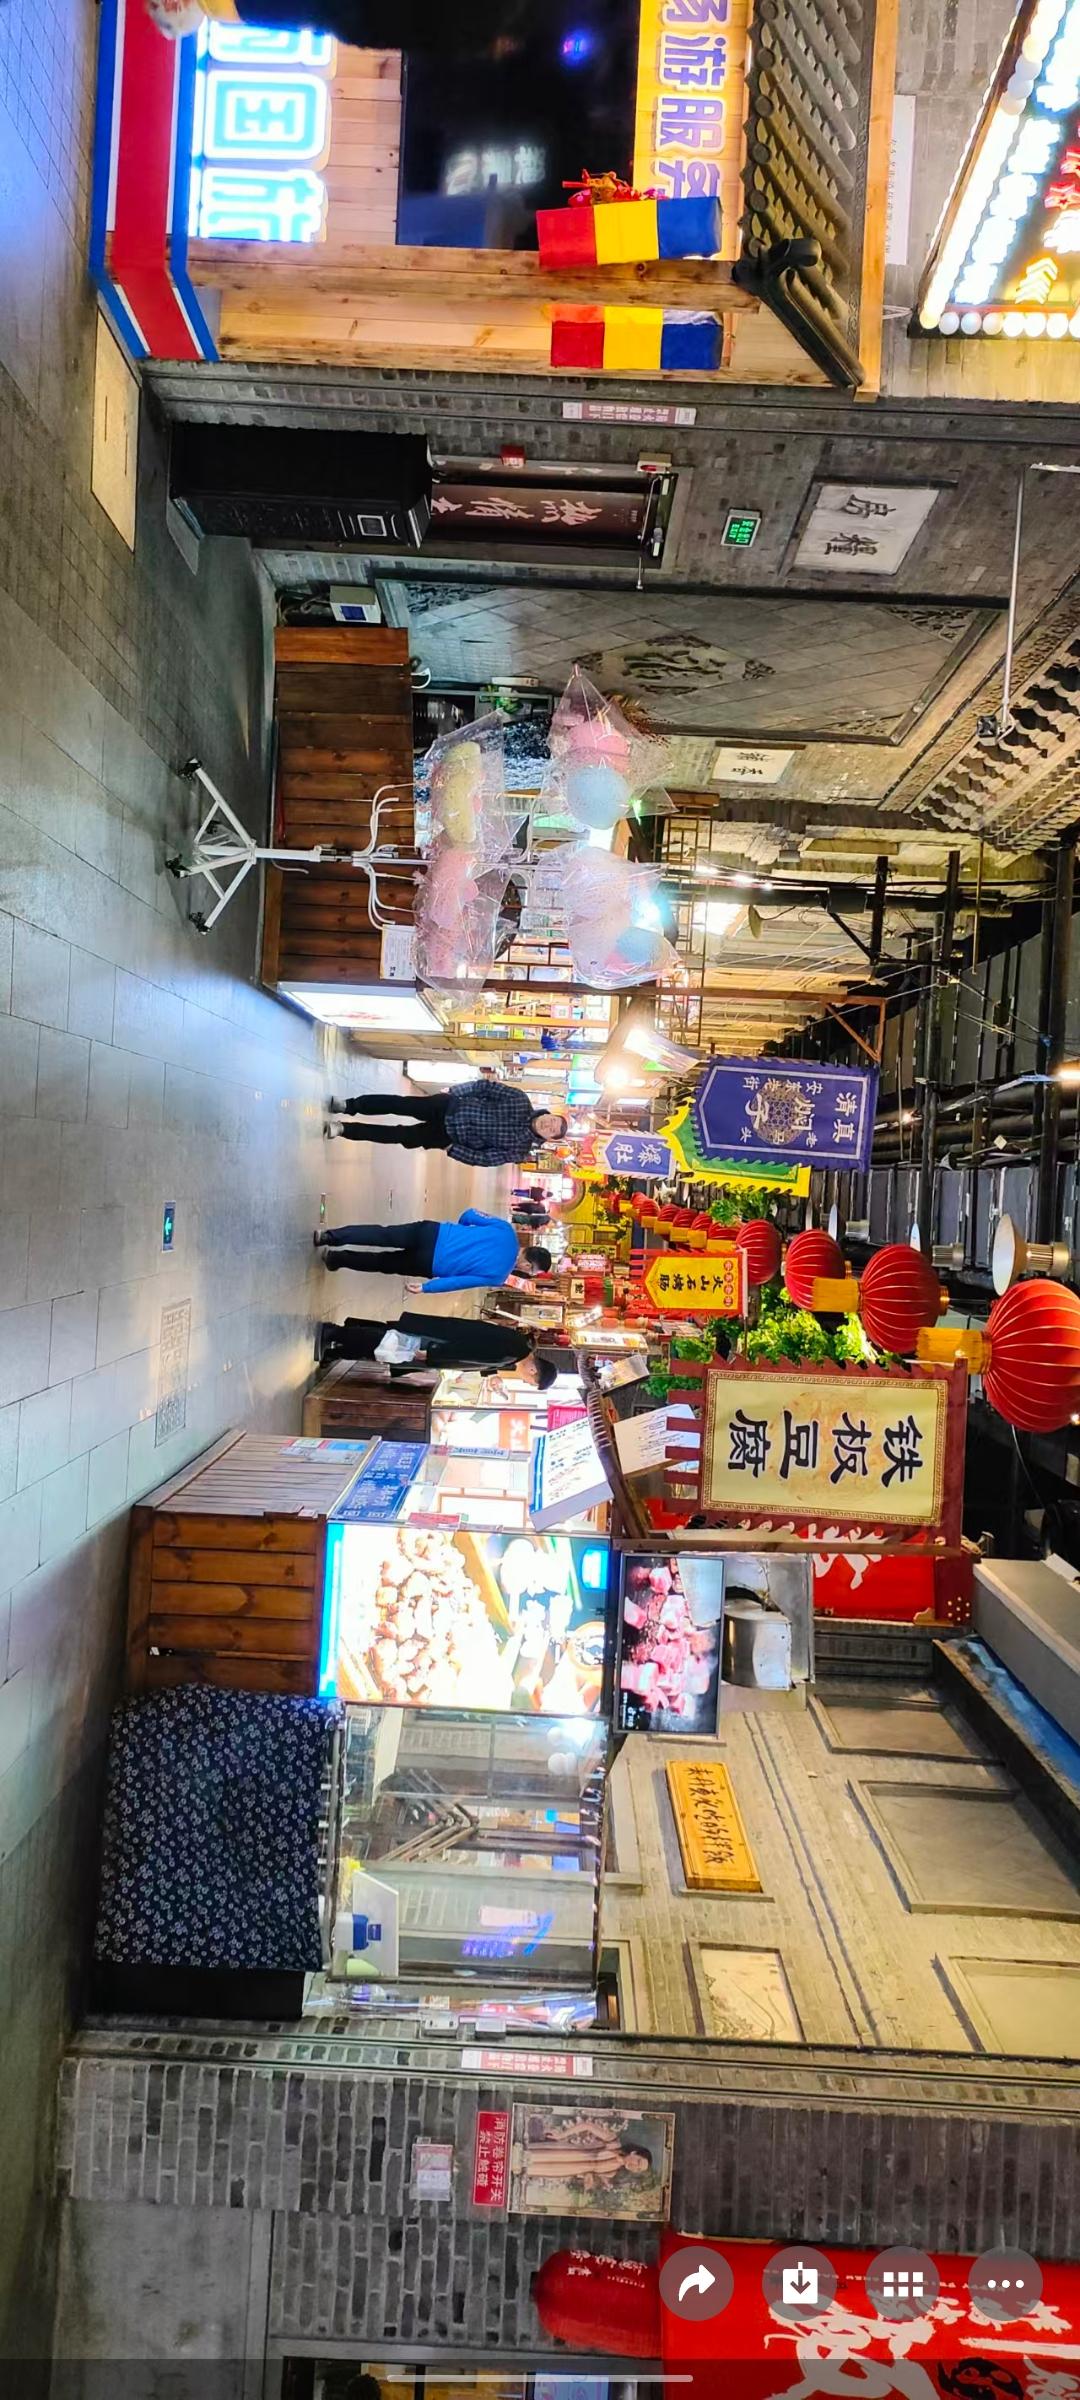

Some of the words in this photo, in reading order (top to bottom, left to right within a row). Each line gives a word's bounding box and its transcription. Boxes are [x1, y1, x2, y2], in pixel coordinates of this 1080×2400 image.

[729, 524, 740, 539] EXIT
[736, 521, 755, 543] 安全出口
[742, 1076, 823, 1096] 安东老街
[744, 1096, 815, 1131] 焖子
[832, 1092, 857, 1144] 清真
[613, 1143, 662, 1168] 爆肚
[659, 1273, 724, 1295] 火山石烤肠
[726, 1409, 923, 1488] 铁板豆腐
[476, 2130, 491, 2188] 禁止触碰
[489, 2117, 506, 2202] 消防卷帘开关
